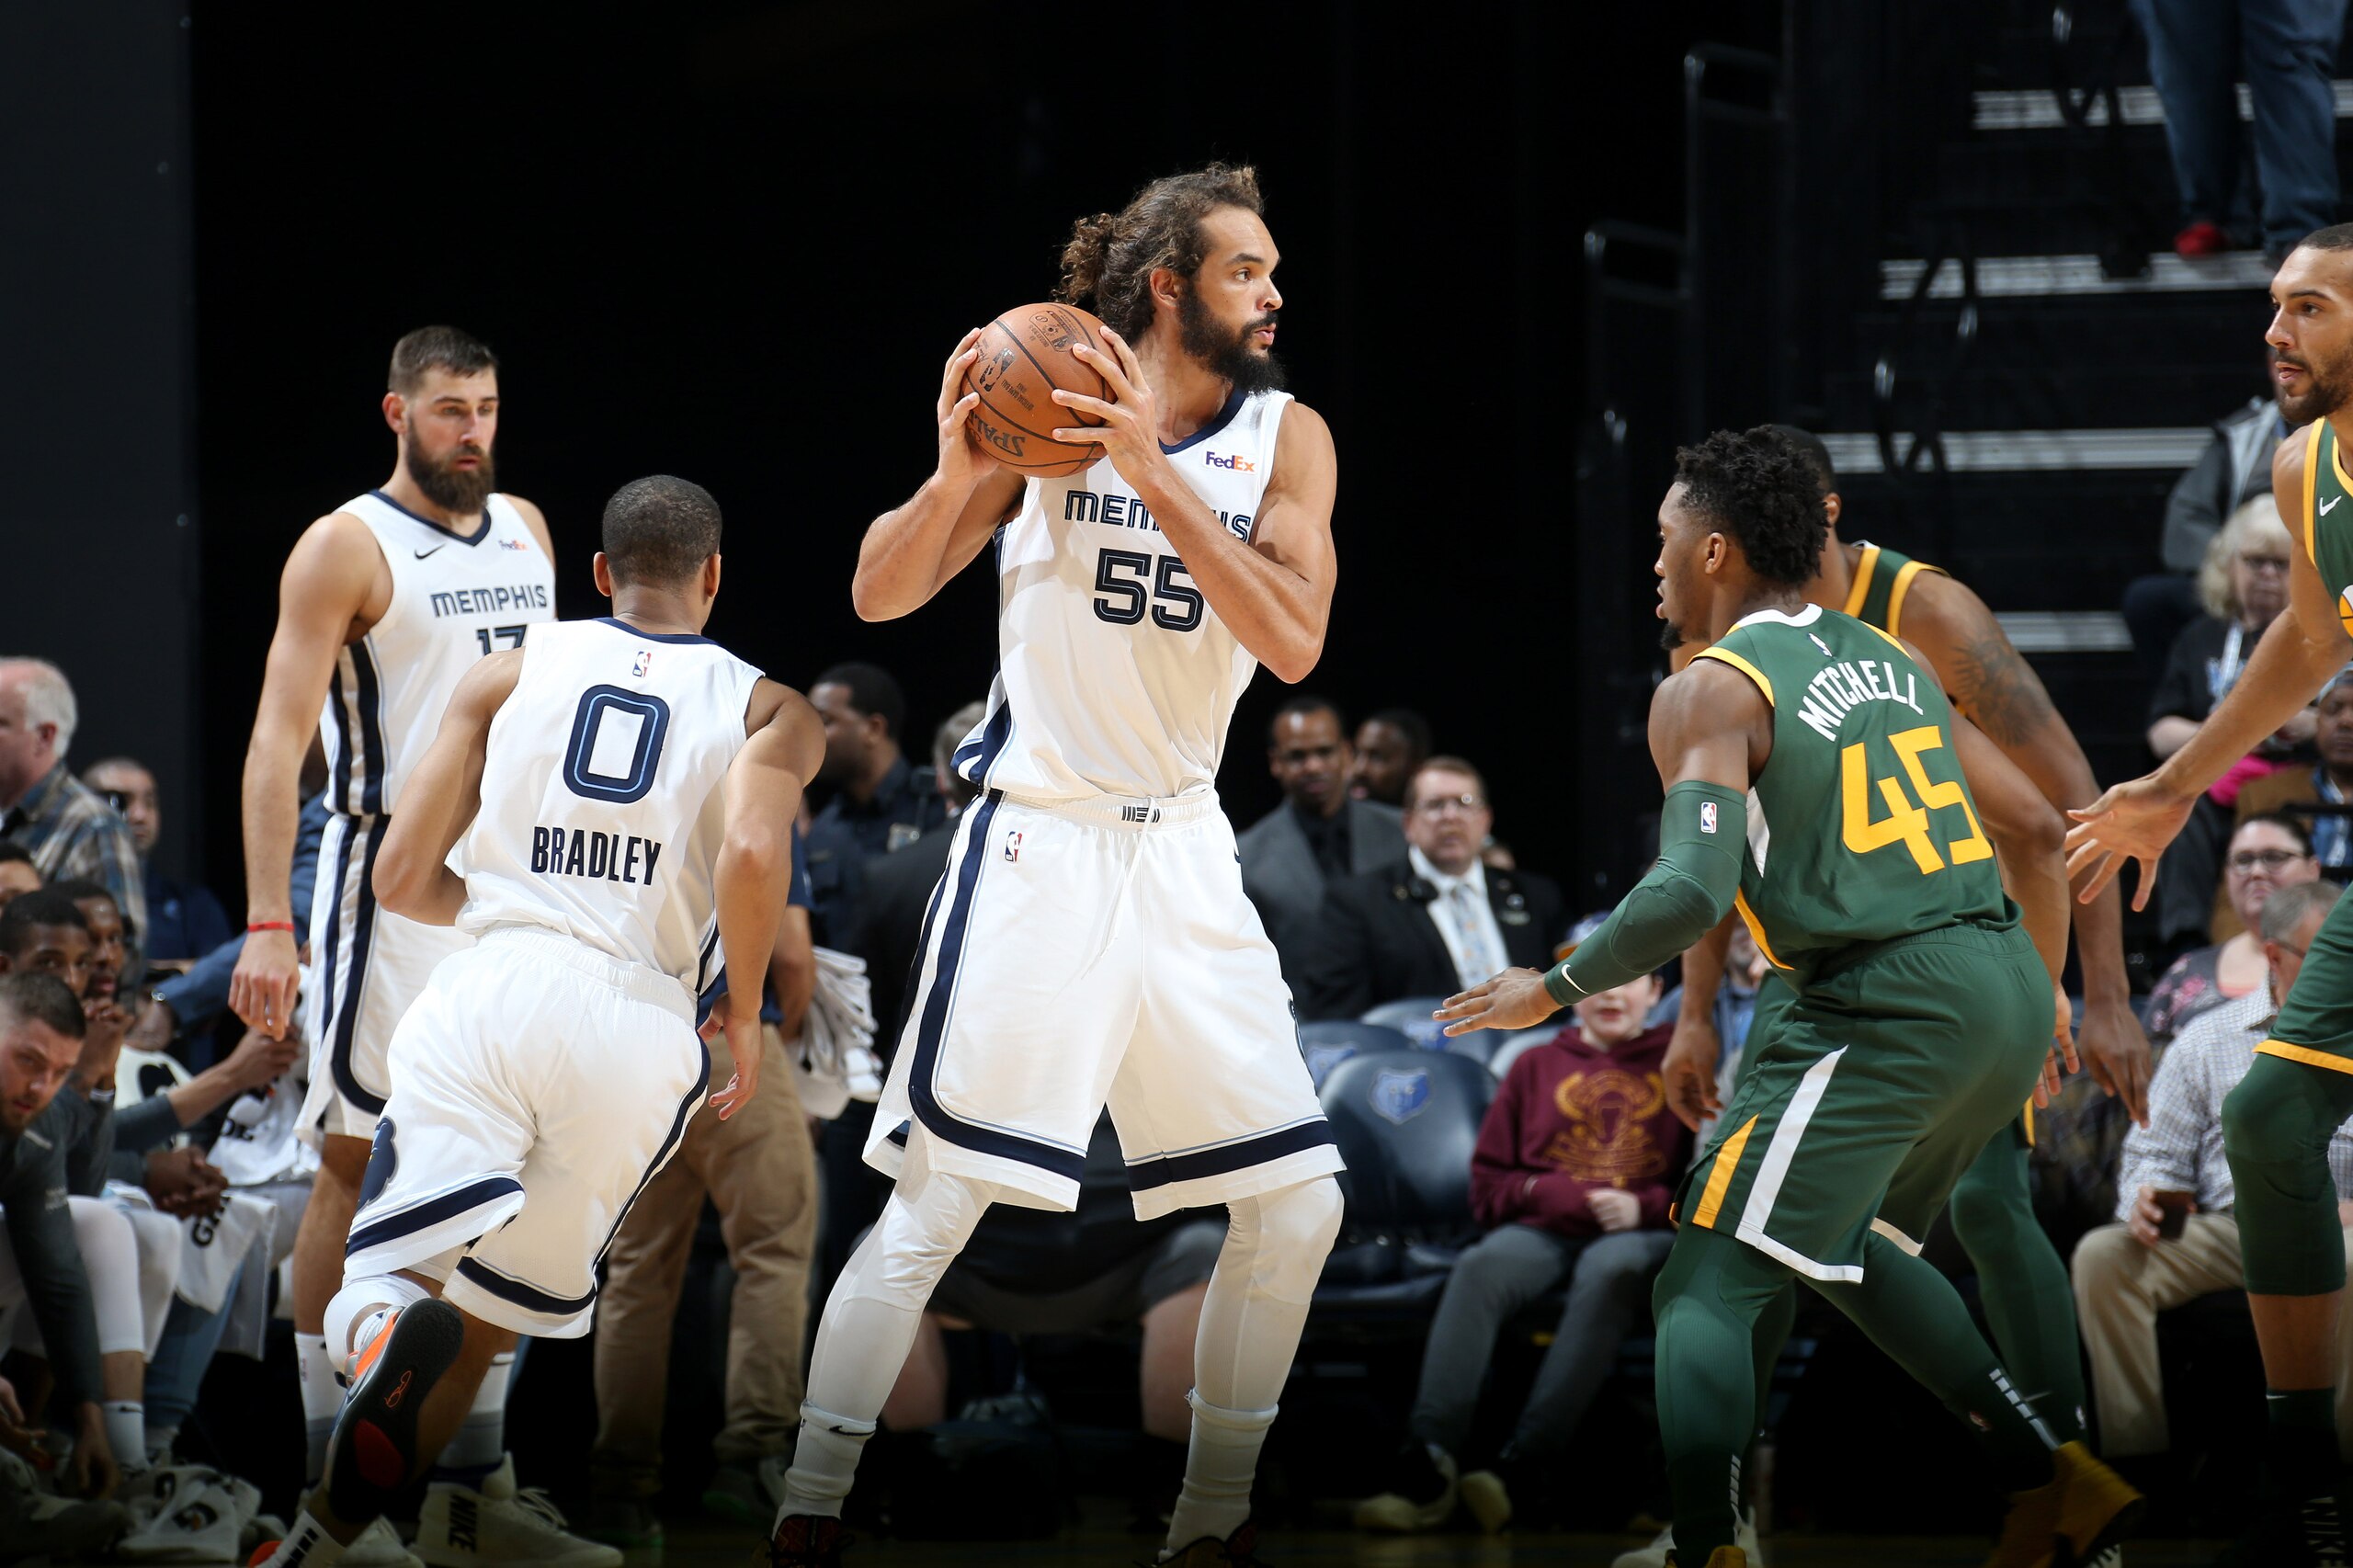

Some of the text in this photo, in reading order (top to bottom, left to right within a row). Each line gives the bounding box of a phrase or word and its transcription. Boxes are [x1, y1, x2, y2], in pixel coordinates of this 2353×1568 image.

[1205, 451, 1256, 472] FedEx
[430, 585, 547, 618] MEMPHIS
[1093, 548, 1204, 632] 55
[476, 624, 528, 656] 17
[1797, 660, 1924, 742] MITCHELL
[563, 684, 671, 804] 0
[1842, 725, 1994, 875] 45
[530, 826, 662, 886] BRADLEY
[449, 1494, 477, 1554] NIKE
